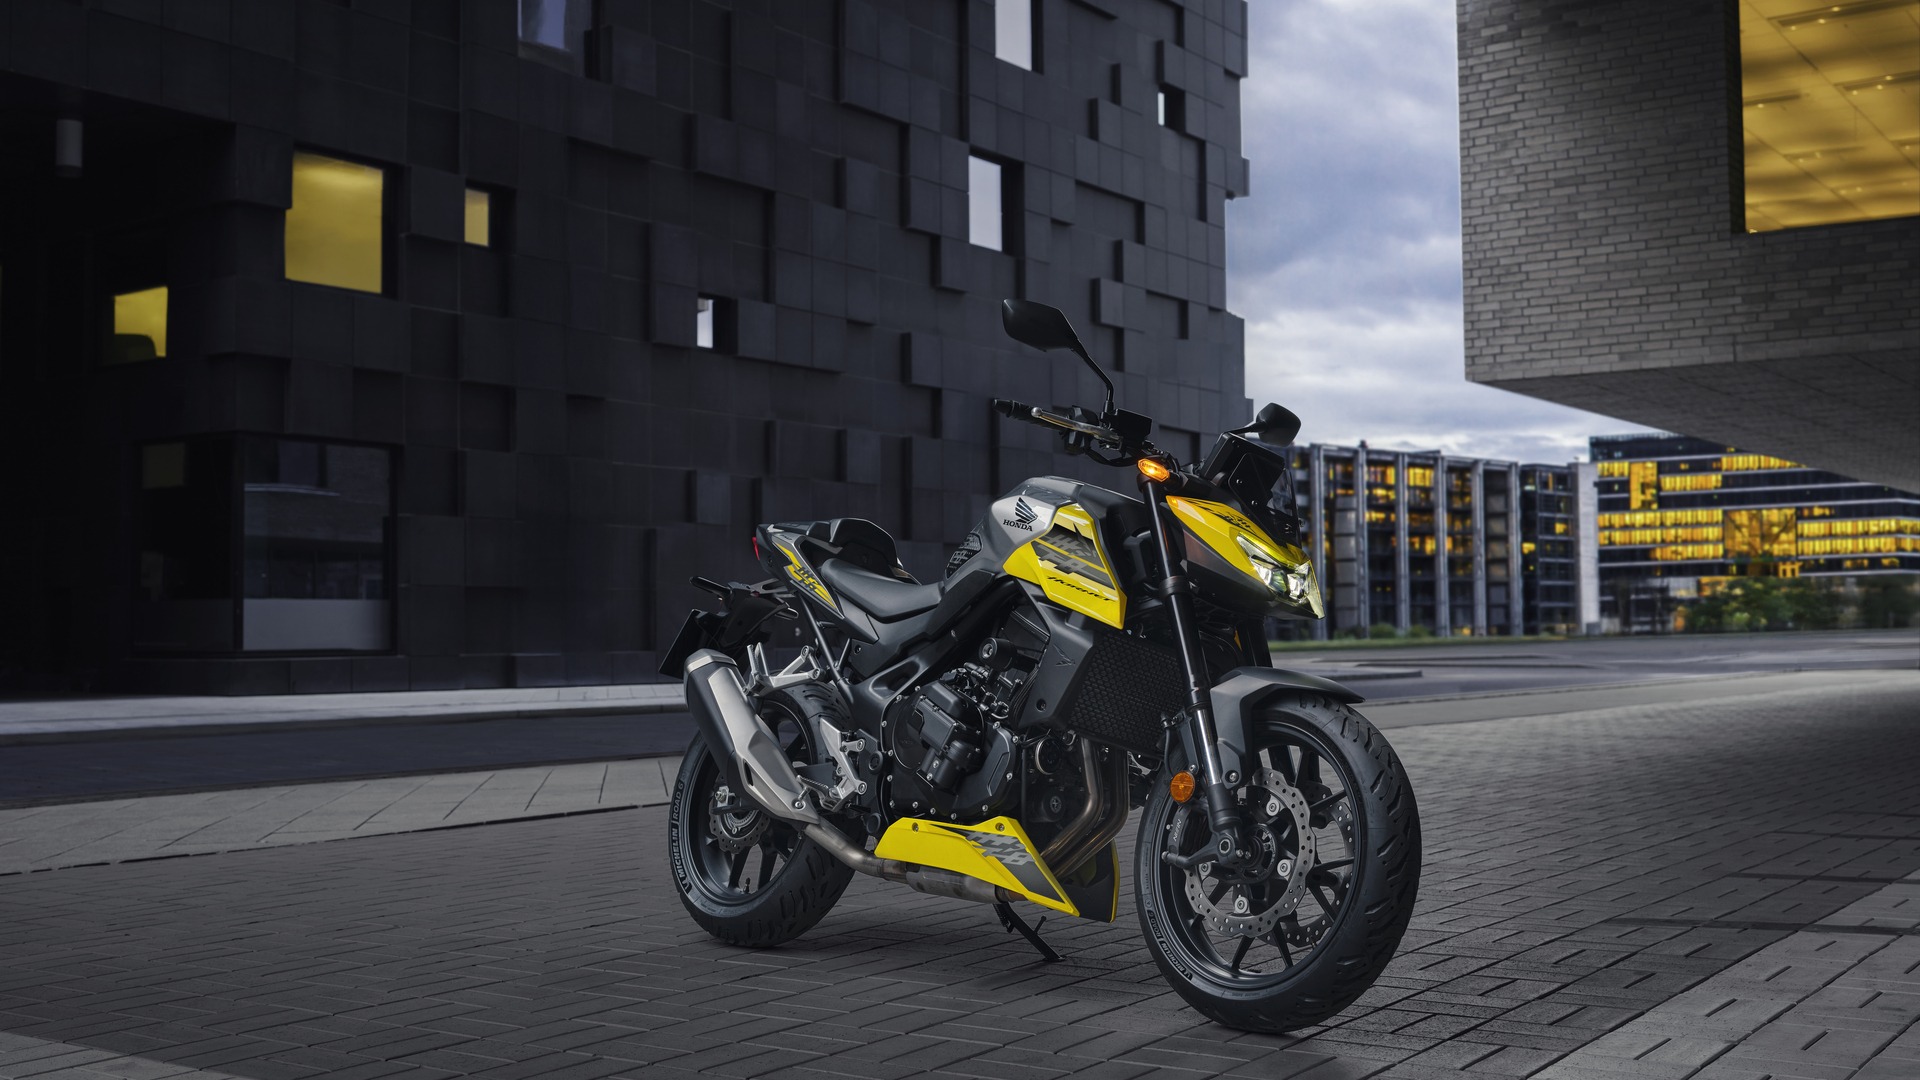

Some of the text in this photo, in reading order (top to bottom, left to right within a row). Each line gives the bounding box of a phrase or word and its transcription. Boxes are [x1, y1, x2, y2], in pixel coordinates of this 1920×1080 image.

[1003, 519, 1033, 532] HONDA
[673, 791, 682, 820] ROAD
[671, 828, 686, 878] MICHELIN
[1150, 918, 1162, 938] ROAD
[1161, 942, 1185, 972] MICHELIN
